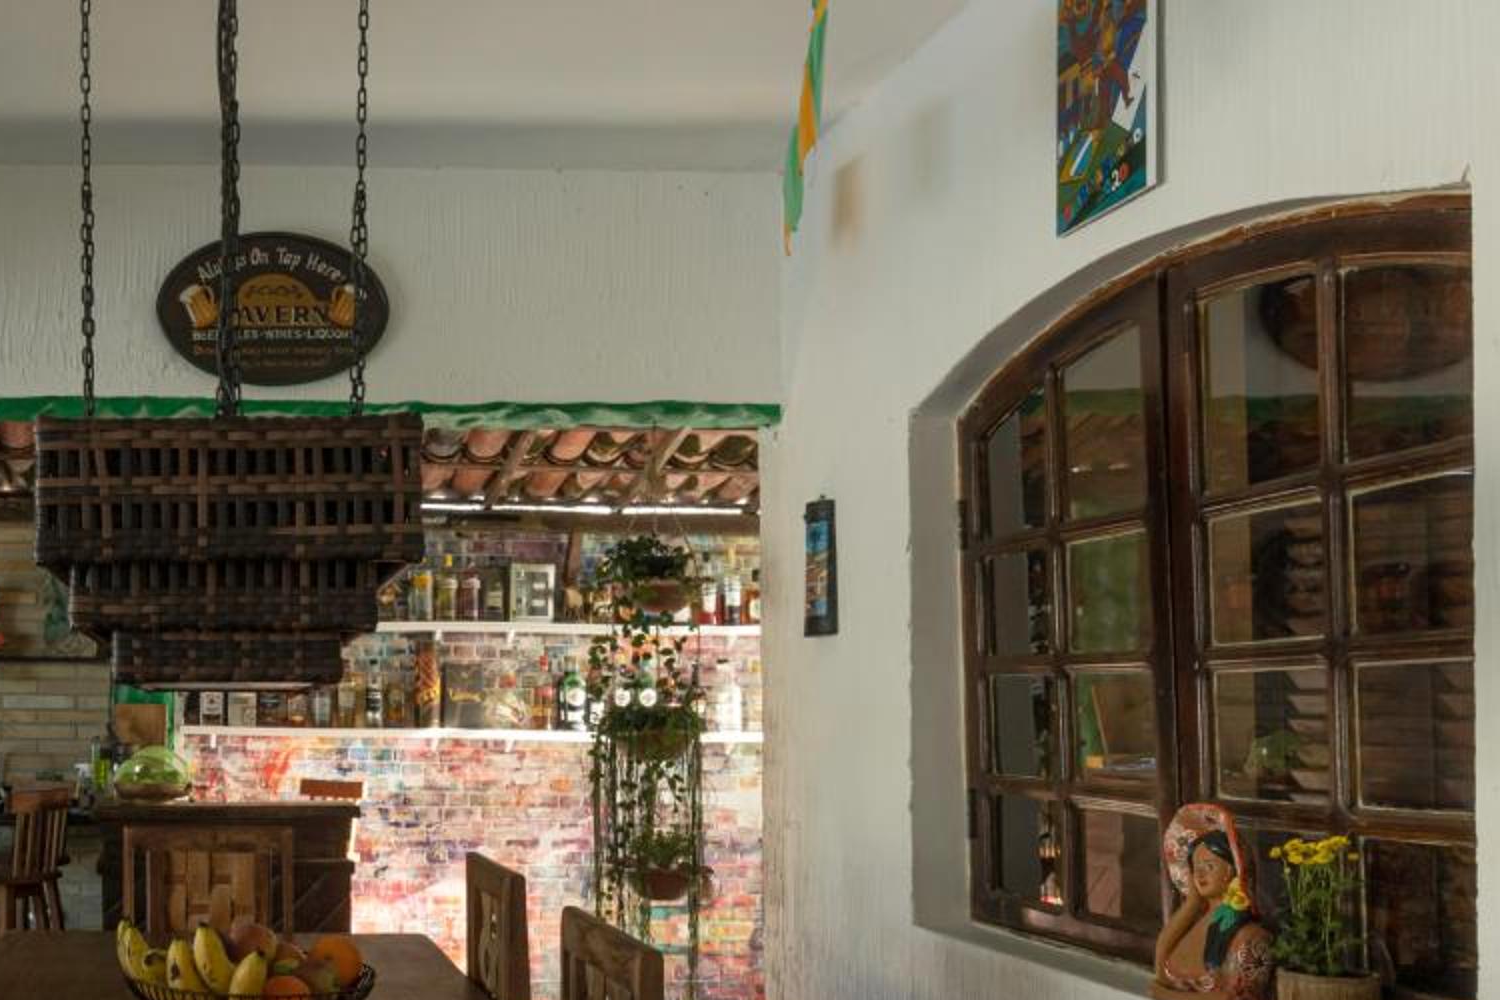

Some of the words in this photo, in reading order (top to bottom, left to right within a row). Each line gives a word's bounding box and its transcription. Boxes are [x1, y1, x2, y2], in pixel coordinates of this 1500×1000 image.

[197, 256, 247, 282] Alwys
[251, 247, 270, 265] On
[276, 247, 301, 270] Tap
[225, 304, 329, 325] AVERN
